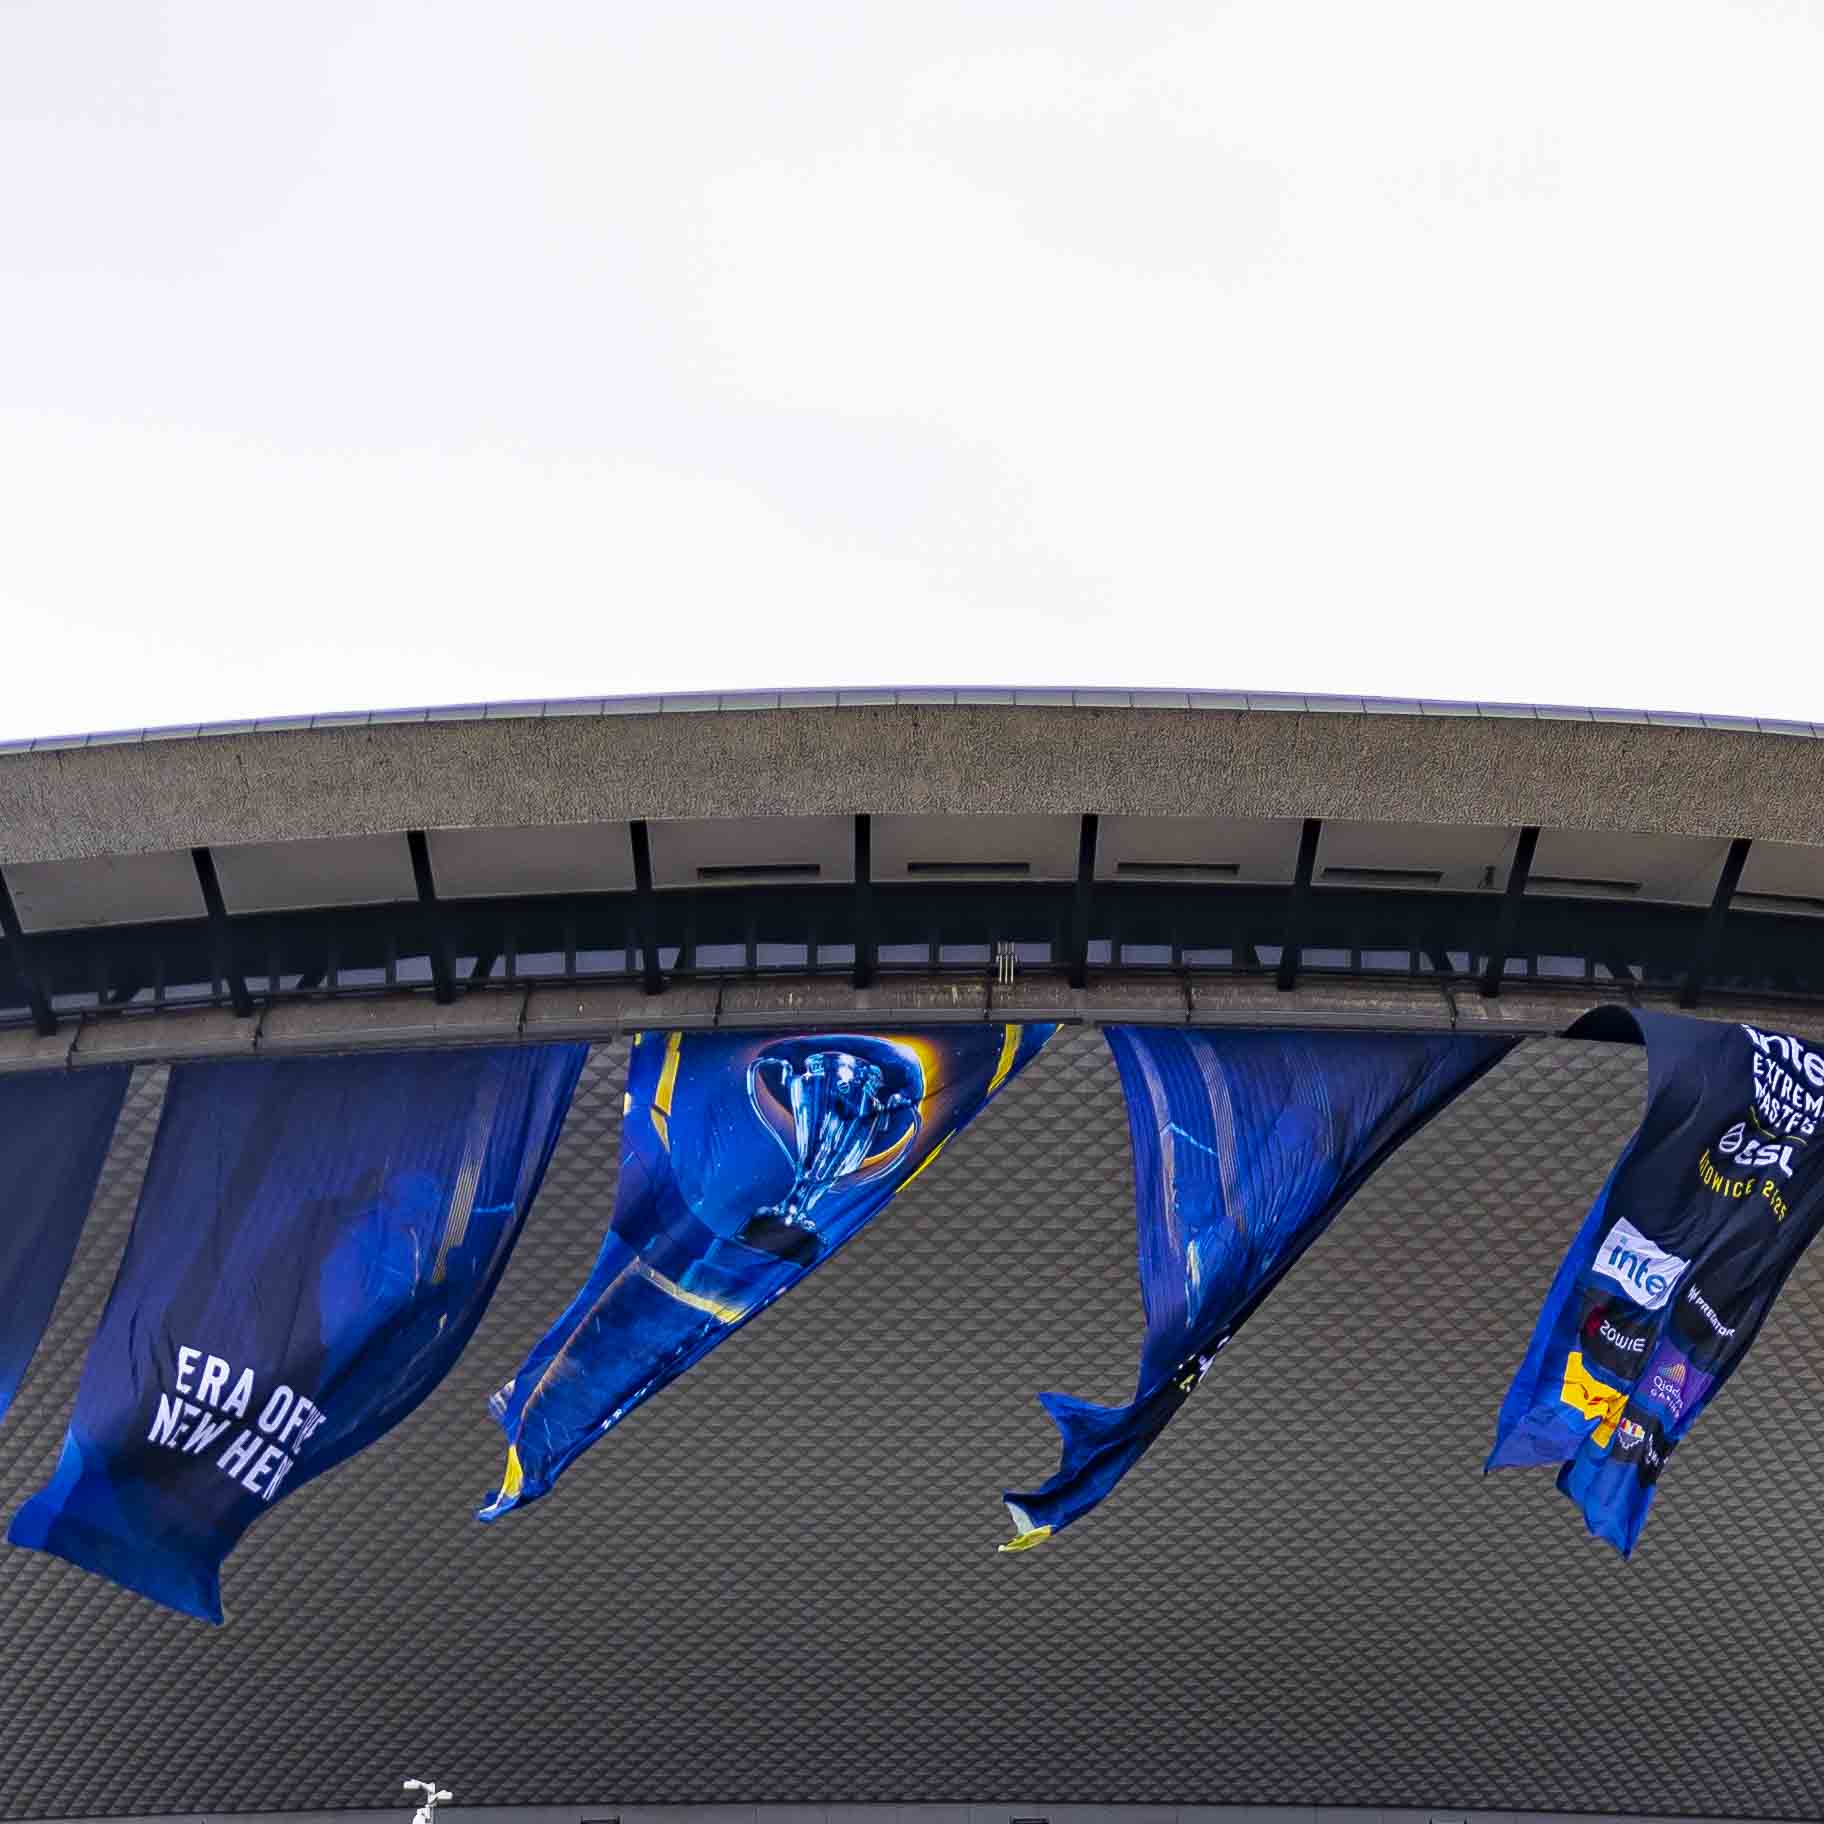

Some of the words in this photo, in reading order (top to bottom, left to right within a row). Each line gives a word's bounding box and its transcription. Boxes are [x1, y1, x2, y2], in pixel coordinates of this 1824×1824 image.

[1734, 1139, 1794, 1178] ESL
[175, 1344, 256, 1420] ERA
[147, 1391, 233, 1455] NEW
